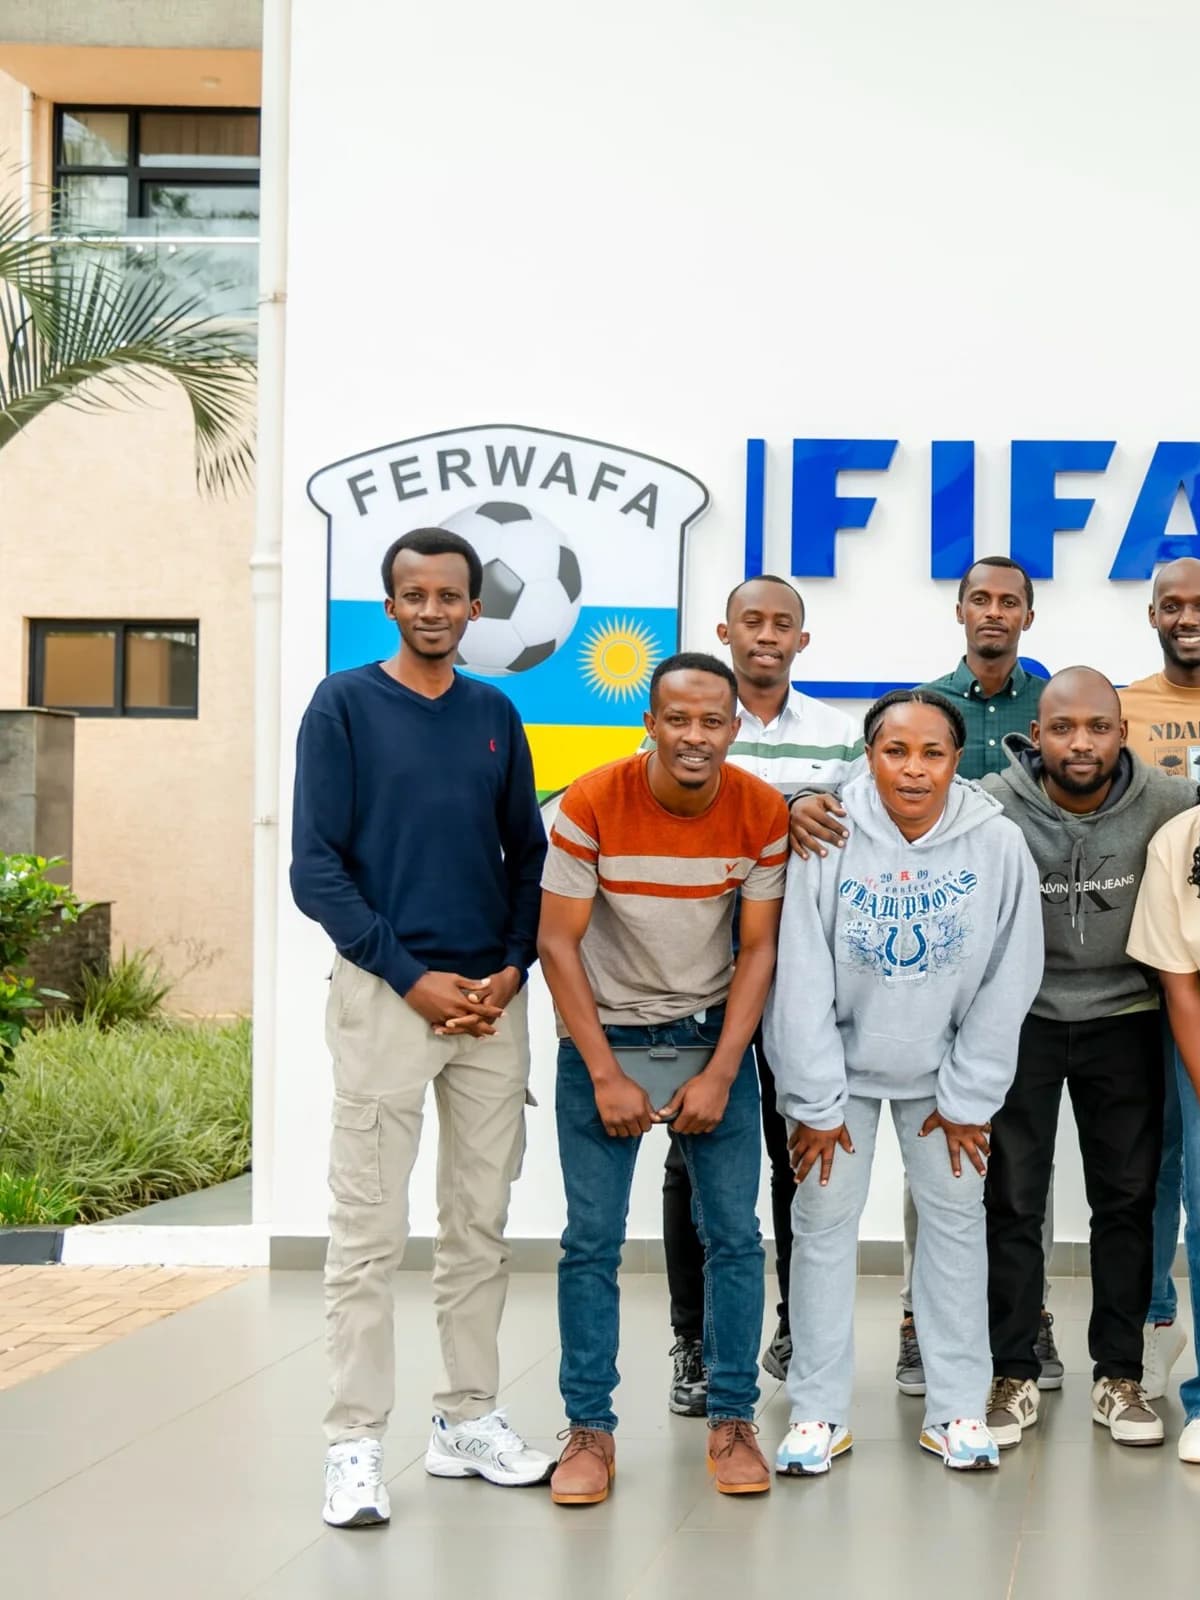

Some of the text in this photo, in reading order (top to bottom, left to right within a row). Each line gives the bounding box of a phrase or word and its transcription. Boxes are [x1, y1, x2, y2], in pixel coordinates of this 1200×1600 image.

[346, 444, 659, 529] FERWAFA
[1039, 882, 1069, 894] ALVIN
[1101, 873, 1136, 891] JEANS
